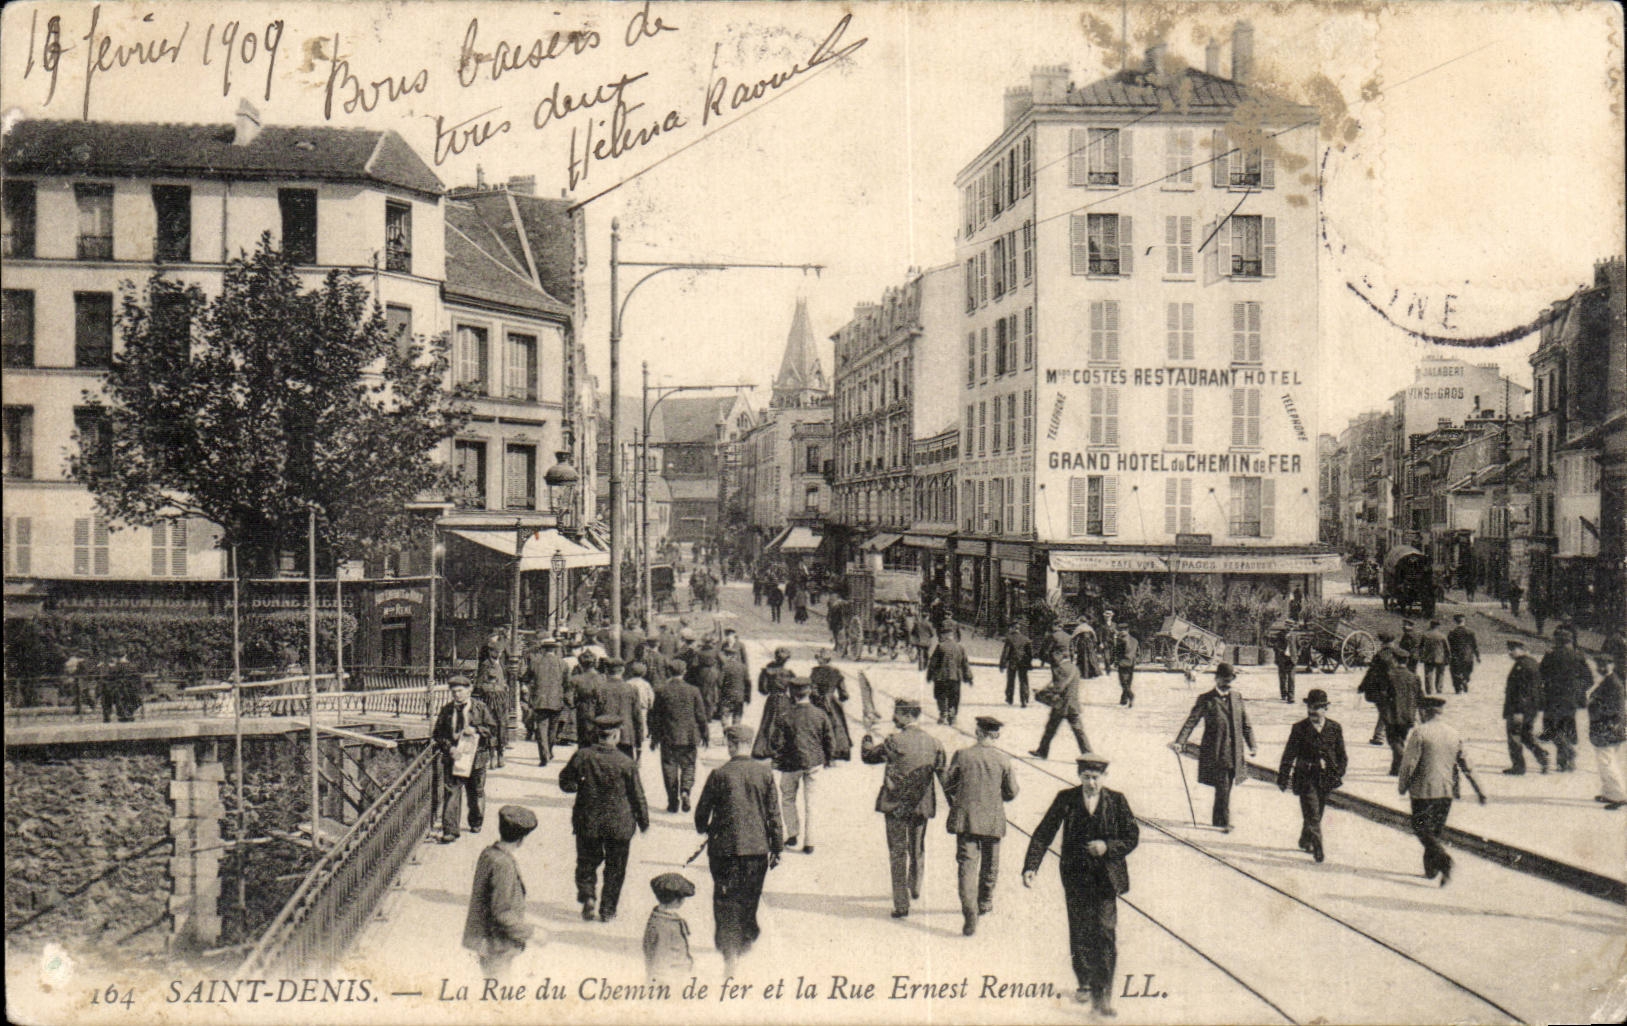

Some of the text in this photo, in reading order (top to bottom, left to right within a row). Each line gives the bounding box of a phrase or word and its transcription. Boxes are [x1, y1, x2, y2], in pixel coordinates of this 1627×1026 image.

[203, 19, 284, 101] 1909
[324, 32, 429, 120] Bons
[625, 3, 679, 47] de
[1073, 368, 1127, 385] COSTES
[1134, 367, 1239, 388] RESTAURANT
[1244, 371, 1302, 385] HOTEL
[1438, 387, 1464, 400] GROS
[1049, 451, 1111, 471] GRAND
[1186, 454, 1250, 473] CHEMIN
[1268, 454, 1301, 473] FER
